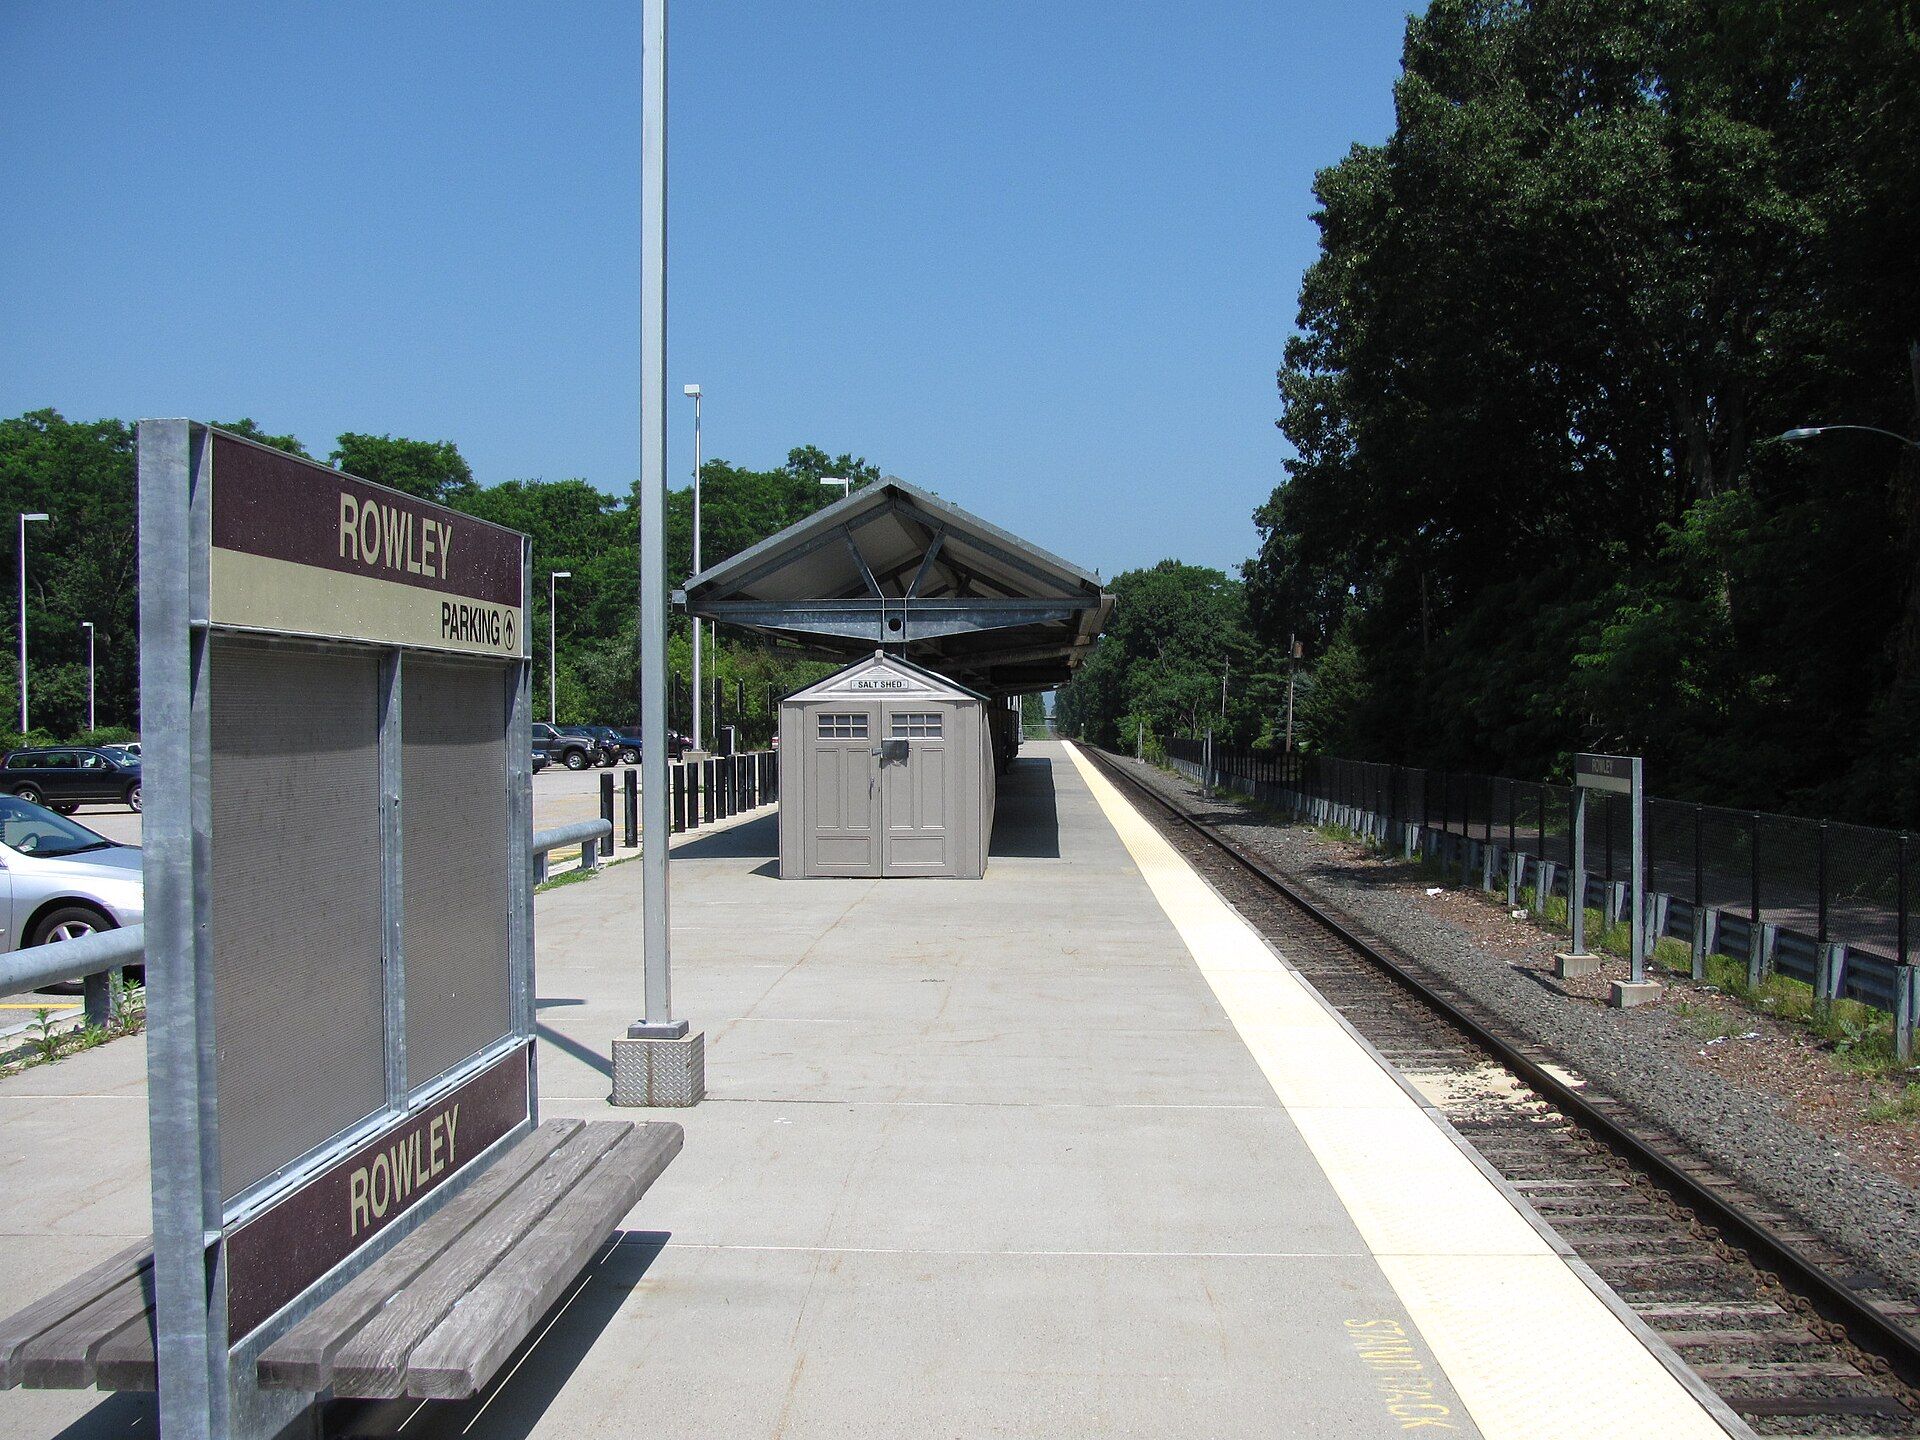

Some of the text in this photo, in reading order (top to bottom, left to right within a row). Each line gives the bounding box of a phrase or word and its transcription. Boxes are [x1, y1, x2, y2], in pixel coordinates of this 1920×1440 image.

[339, 492, 453, 580] ROWLEY
[441, 602, 501, 646] PARKING
[350, 1103, 460, 1237] ROWLEY
